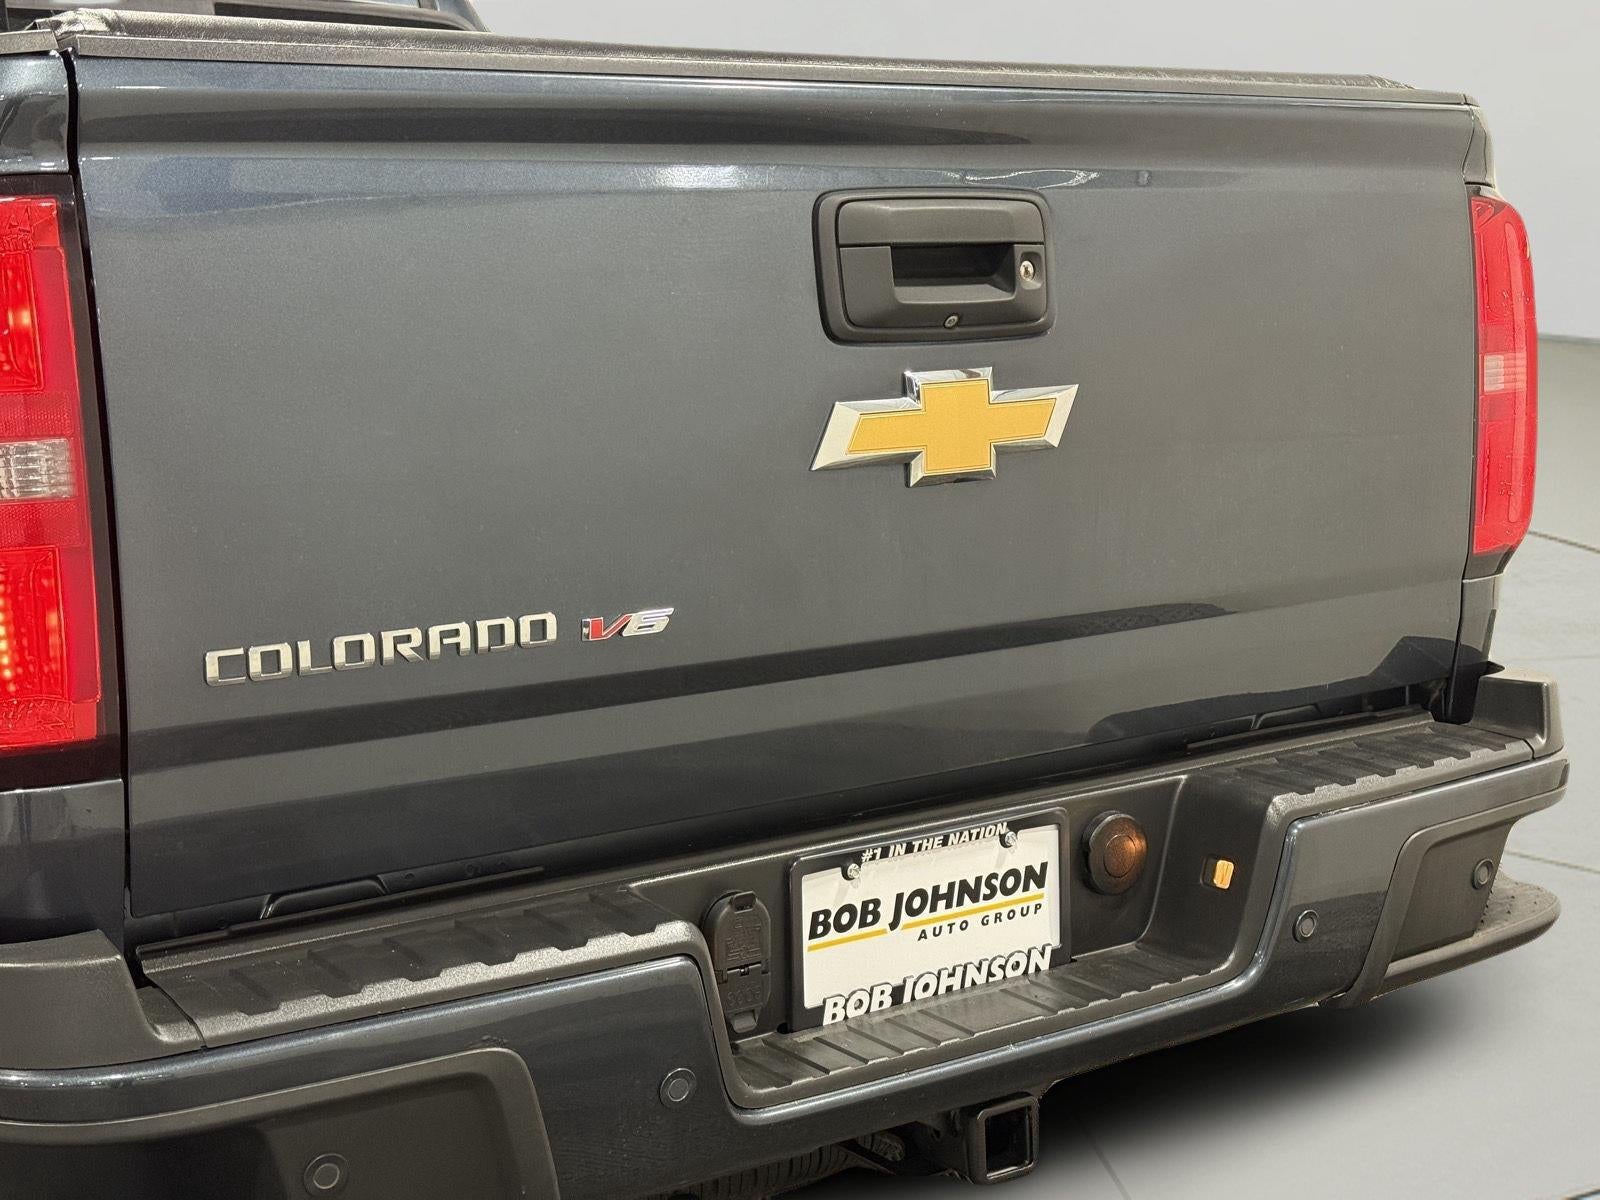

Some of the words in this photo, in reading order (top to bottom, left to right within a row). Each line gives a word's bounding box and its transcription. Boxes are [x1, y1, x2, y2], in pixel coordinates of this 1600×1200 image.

[204, 611, 558, 686] COLORADO
[581, 607, 675, 642] V6
[861, 847, 881, 863] #1
[888, 843, 906, 858] IN
[912, 835, 944, 853] THE
[948, 822, 1008, 845] NATION
[808, 897, 882, 941] BOB
[889, 861, 1049, 930] JOHNSON
[917, 919, 970, 942] AUTO
[981, 903, 1043, 927] GROUP
[822, 981, 893, 1026] BOB
[902, 944, 1053, 1004] JOHNSON
